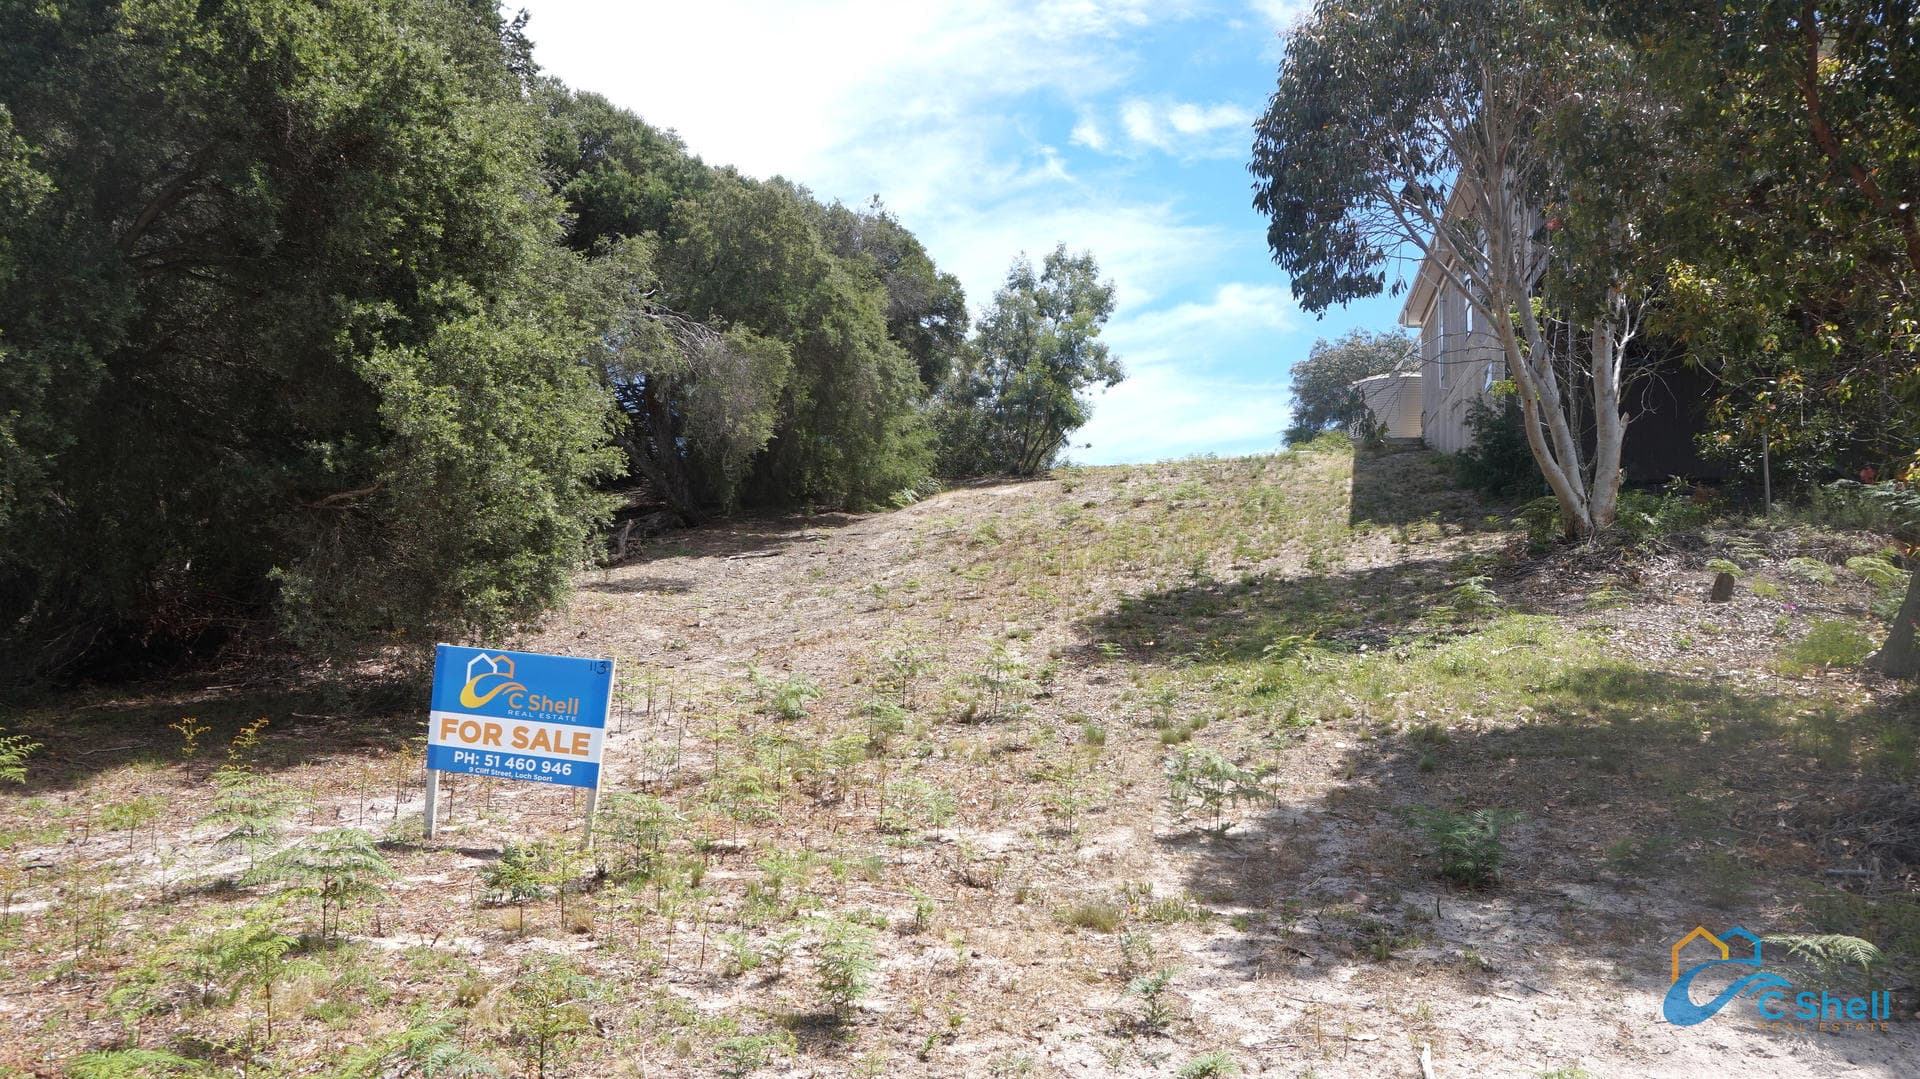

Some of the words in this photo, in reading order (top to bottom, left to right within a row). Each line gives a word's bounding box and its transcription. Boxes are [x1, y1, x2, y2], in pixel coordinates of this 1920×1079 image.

[507, 709, 534, 718] REAL
[539, 712, 577, 722] ESTATE
[508, 692, 524, 709] C
[528, 694, 580, 716] Shell
[440, 717, 503, 747] FOR
[511, 725, 591, 757] SALE
[453, 750, 480, 765] PH:
[484, 754, 500, 768] 51
[504, 757, 537, 772] 460
[541, 760, 572, 776] 946
[475, 767, 489, 775] Cliff
[491, 770, 514, 779] Street,
[515, 772, 532, 780] Loch
[533, 774, 553, 783] Sport
